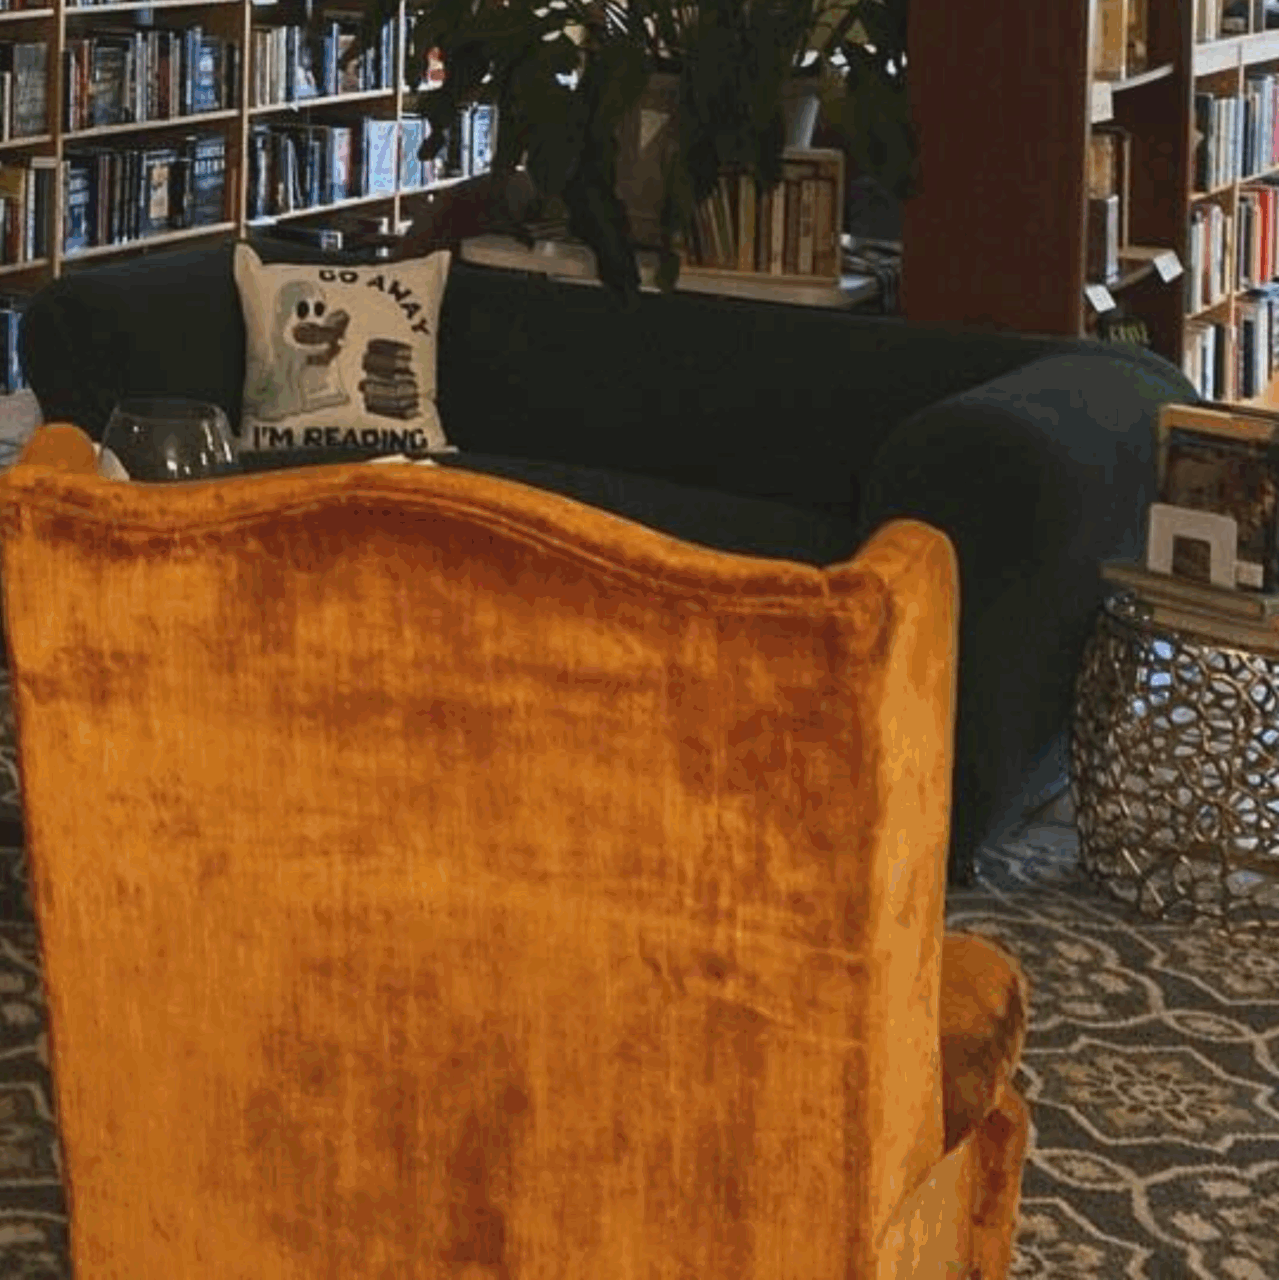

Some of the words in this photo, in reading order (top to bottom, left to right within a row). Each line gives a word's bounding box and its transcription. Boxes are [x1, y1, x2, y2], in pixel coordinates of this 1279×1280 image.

[318, 270, 359, 284] GO
[366, 275, 431, 336] AWAY
[253, 426, 294, 448] I'M
[303, 427, 429, 450] READING
